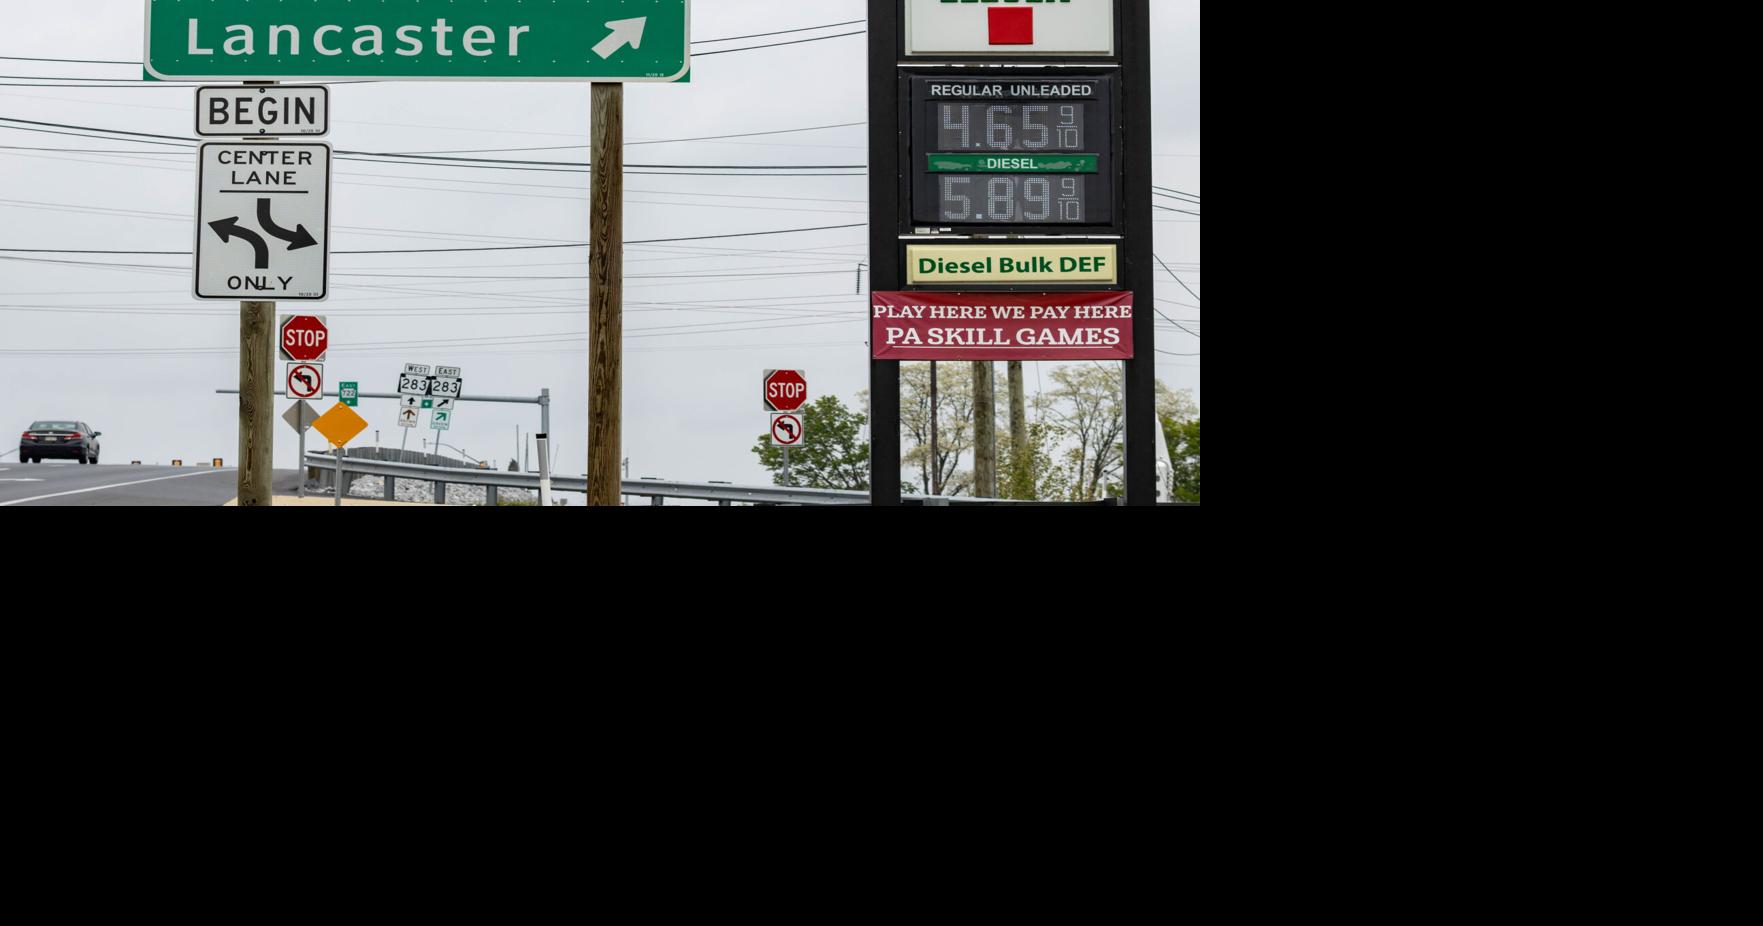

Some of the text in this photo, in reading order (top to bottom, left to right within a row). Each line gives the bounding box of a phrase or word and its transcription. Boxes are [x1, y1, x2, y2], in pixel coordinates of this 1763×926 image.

[188, 18, 530, 56] Lancaster
[931, 85, 1092, 96] REGULAR UNLEADED
[209, 97, 315, 125] BEGIN
[943, 105, 1049, 148] 4.65
[218, 150, 312, 165] CENTER
[987, 158, 1038, 169] DIESEL
[231, 170, 296, 185] LANE
[944, 177, 1050, 220] 5.89
[918, 256, 1106, 274] Diesel Bulk DEF
[227, 275, 293, 290] ONLY
[873, 305, 1132, 319] PLAY HERE WE PAY HERE
[285, 329, 325, 347] STOP
[885, 327, 1120, 345] PA SKILL GAMES
[408, 365, 427, 373] WEST
[438, 367, 457, 375] EAST
[401, 378, 427, 391] 283
[432, 380, 458, 393] 283
[769, 382, 805, 398] STOP
